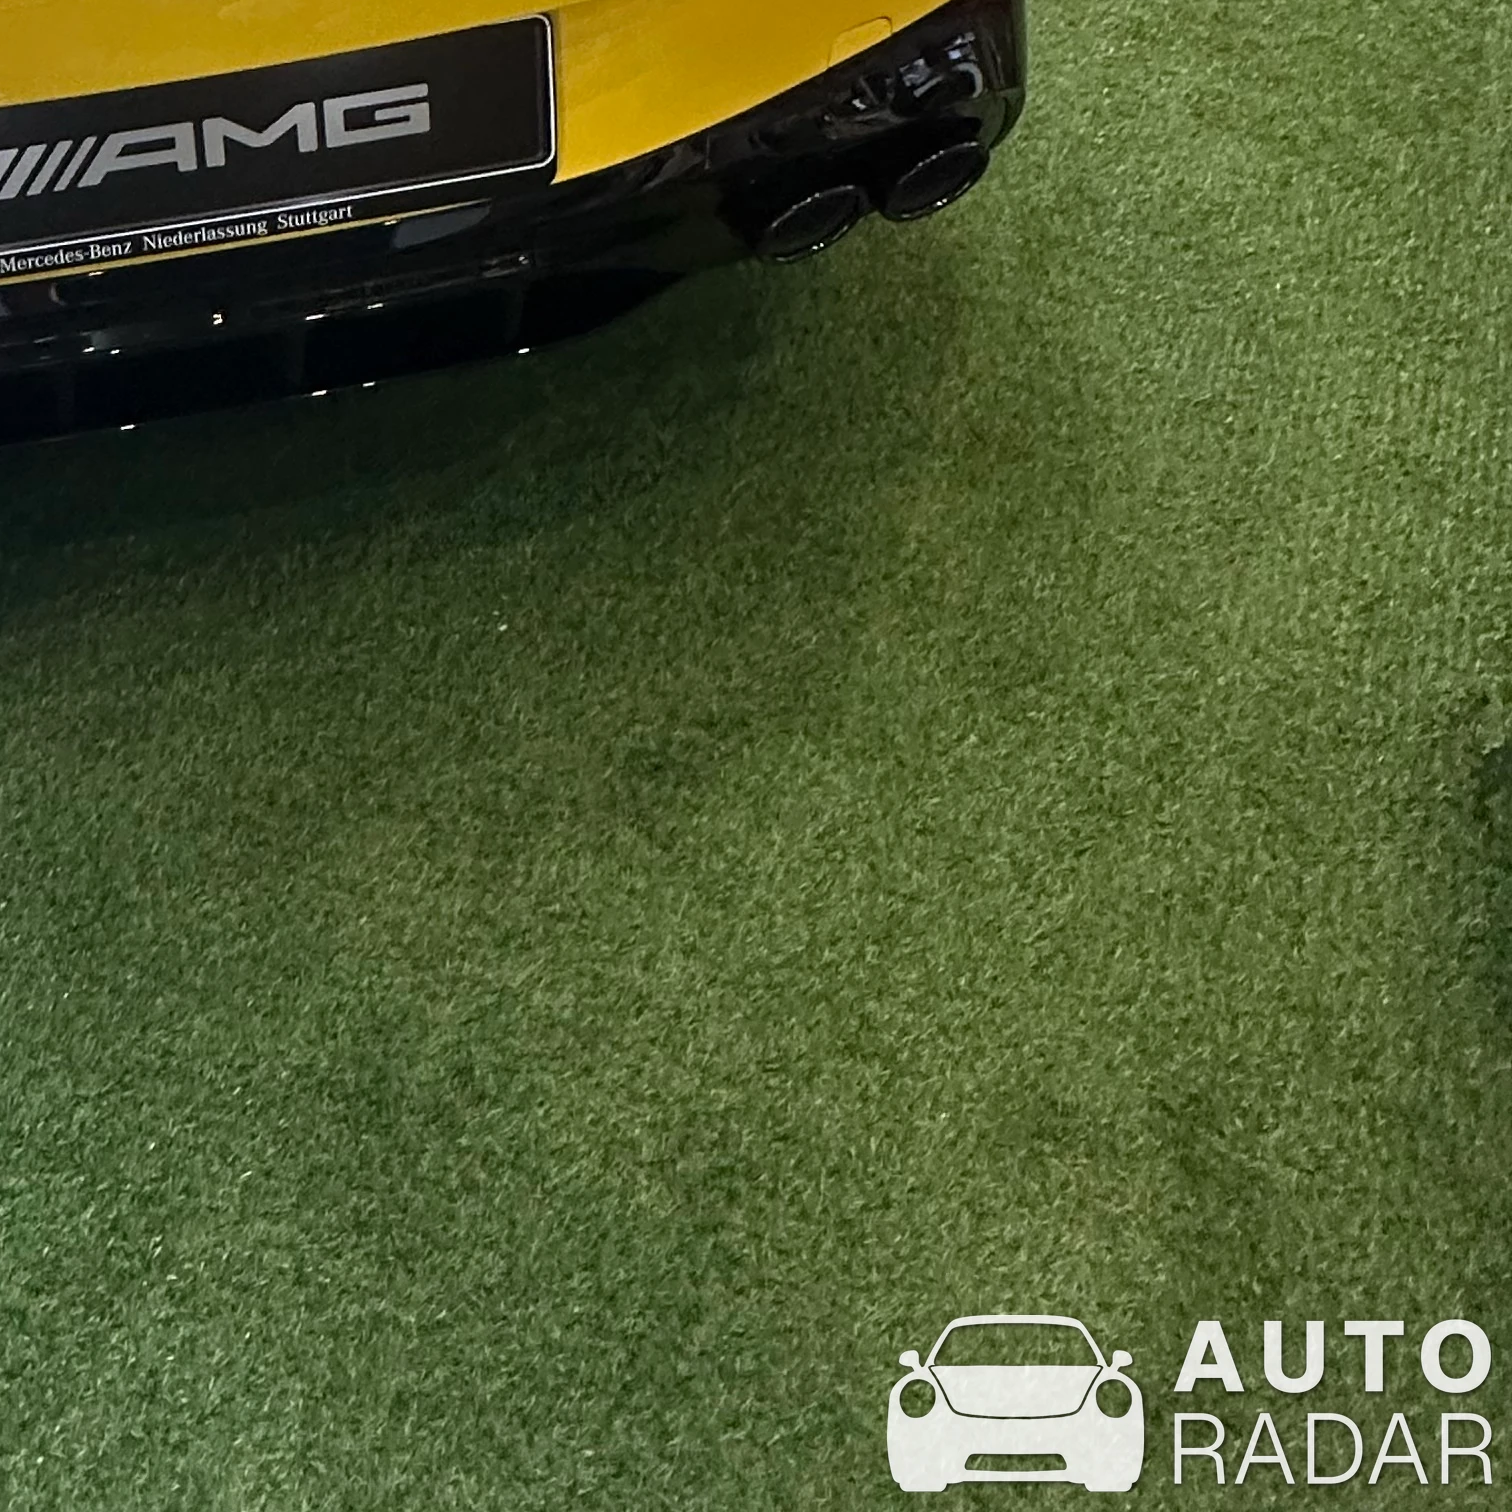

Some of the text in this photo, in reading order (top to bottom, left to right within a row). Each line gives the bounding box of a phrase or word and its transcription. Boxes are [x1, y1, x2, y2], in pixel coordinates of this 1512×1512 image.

[78, 83, 431, 188] AMG
[0, 204, 354, 274] Mercedes-Benz Niederlassung Stuttgart
